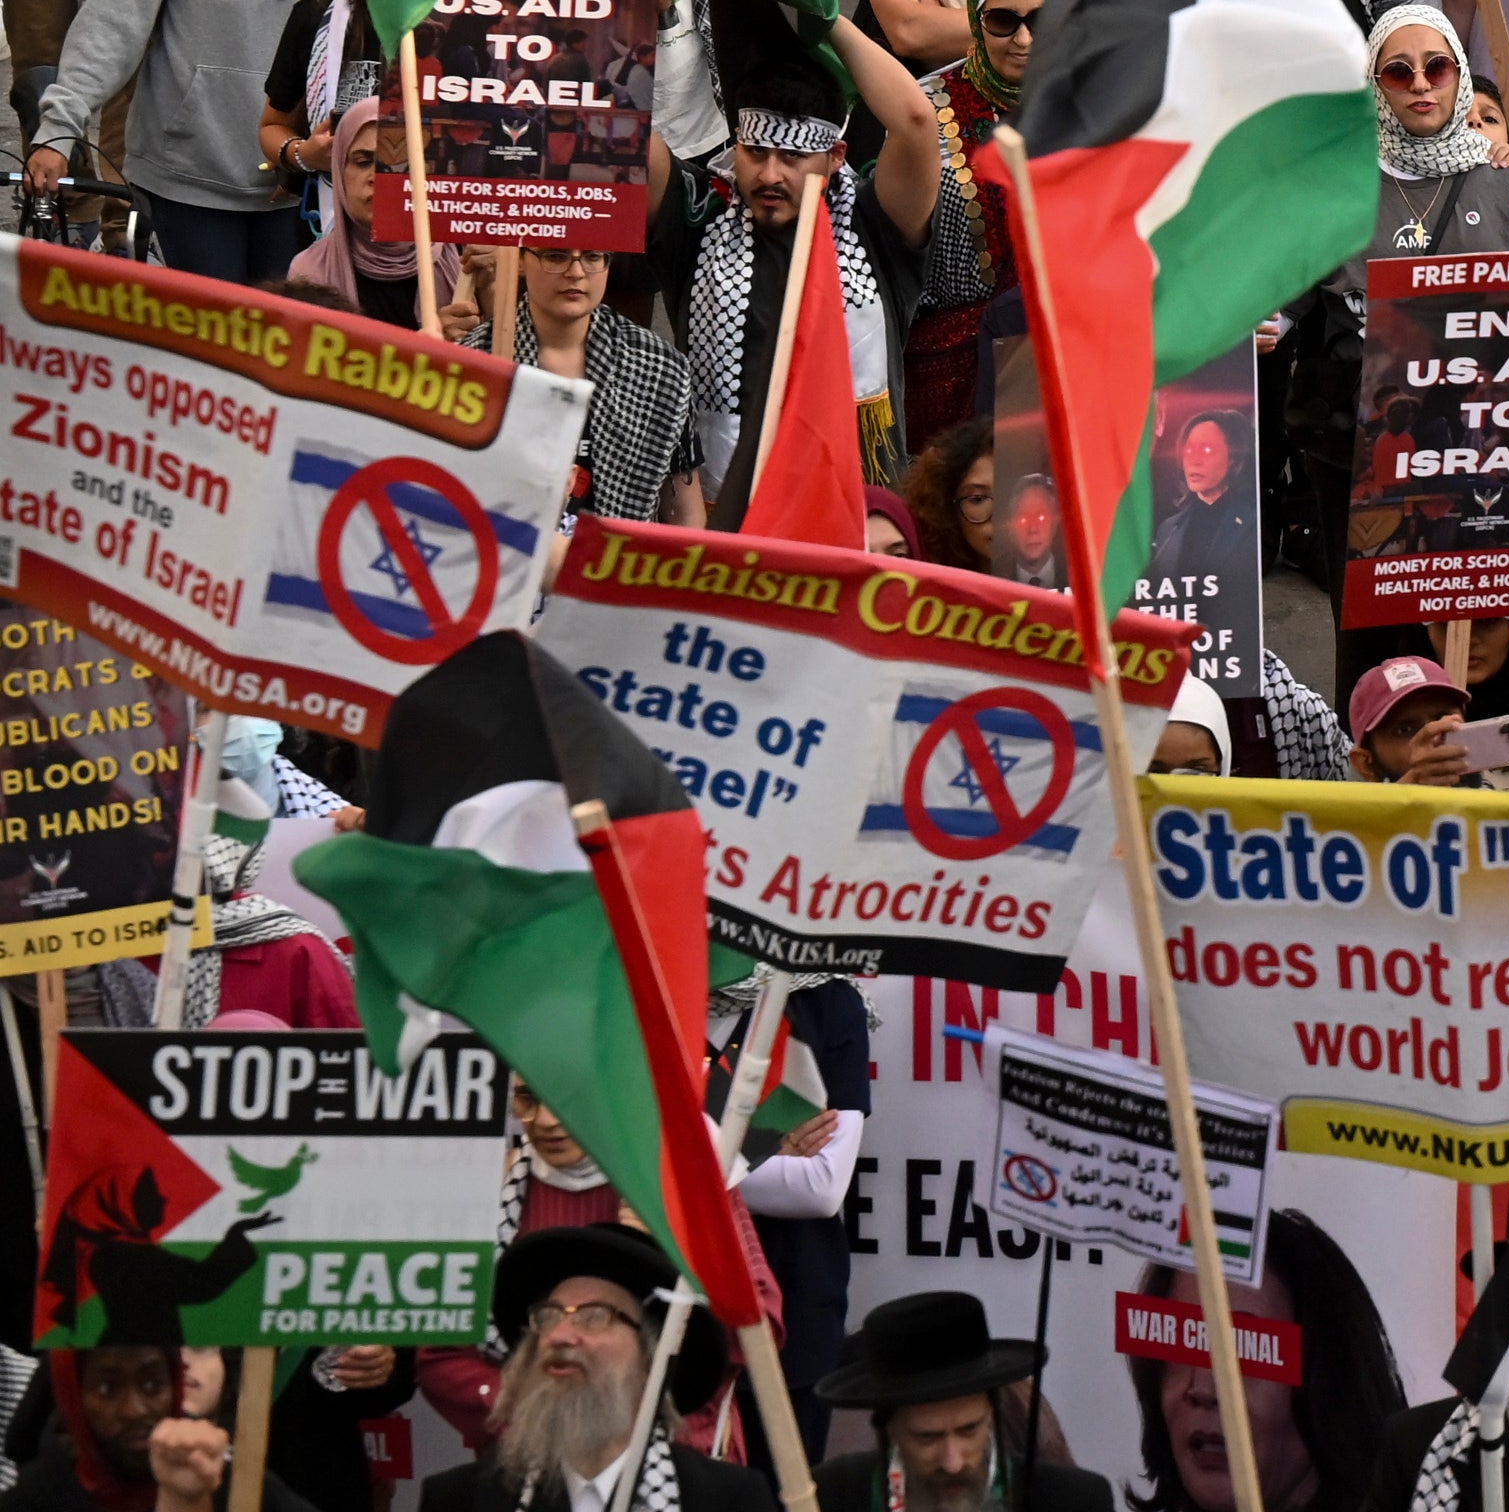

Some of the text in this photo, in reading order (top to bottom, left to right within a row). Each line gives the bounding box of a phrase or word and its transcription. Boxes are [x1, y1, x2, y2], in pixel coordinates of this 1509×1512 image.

[486, 34, 552, 61] TO
[422, 76, 612, 109] ISRAEL
[1412, 266, 1465, 287] FREE
[41, 266, 488, 425] Authentic Rabbis
[125, 362, 276, 455] opposed
[11, 394, 231, 515] Zionism
[71, 466, 173, 528] and the
[95, 521, 243, 627] of Israel
[582, 533, 841, 614] Judaism
[87, 599, 367, 735] www.NKUSA.org
[664, 623, 766, 680] the
[577, 666, 827, 768] state of
[760, 856, 1052, 940] Atrocities
[1154, 809, 1366, 901] State
[1388, 820, 1463, 916] of
[1165, 926, 1450, 1005] does not
[150, 1045, 496, 1122] STOP THE WAR
[1294, 1017, 1462, 1088] world
[262, 1252, 479, 1306] PEACE
[260, 1310, 473, 1333] FOR PALESTINE
[1127, 1308, 1176, 1345] WAR
